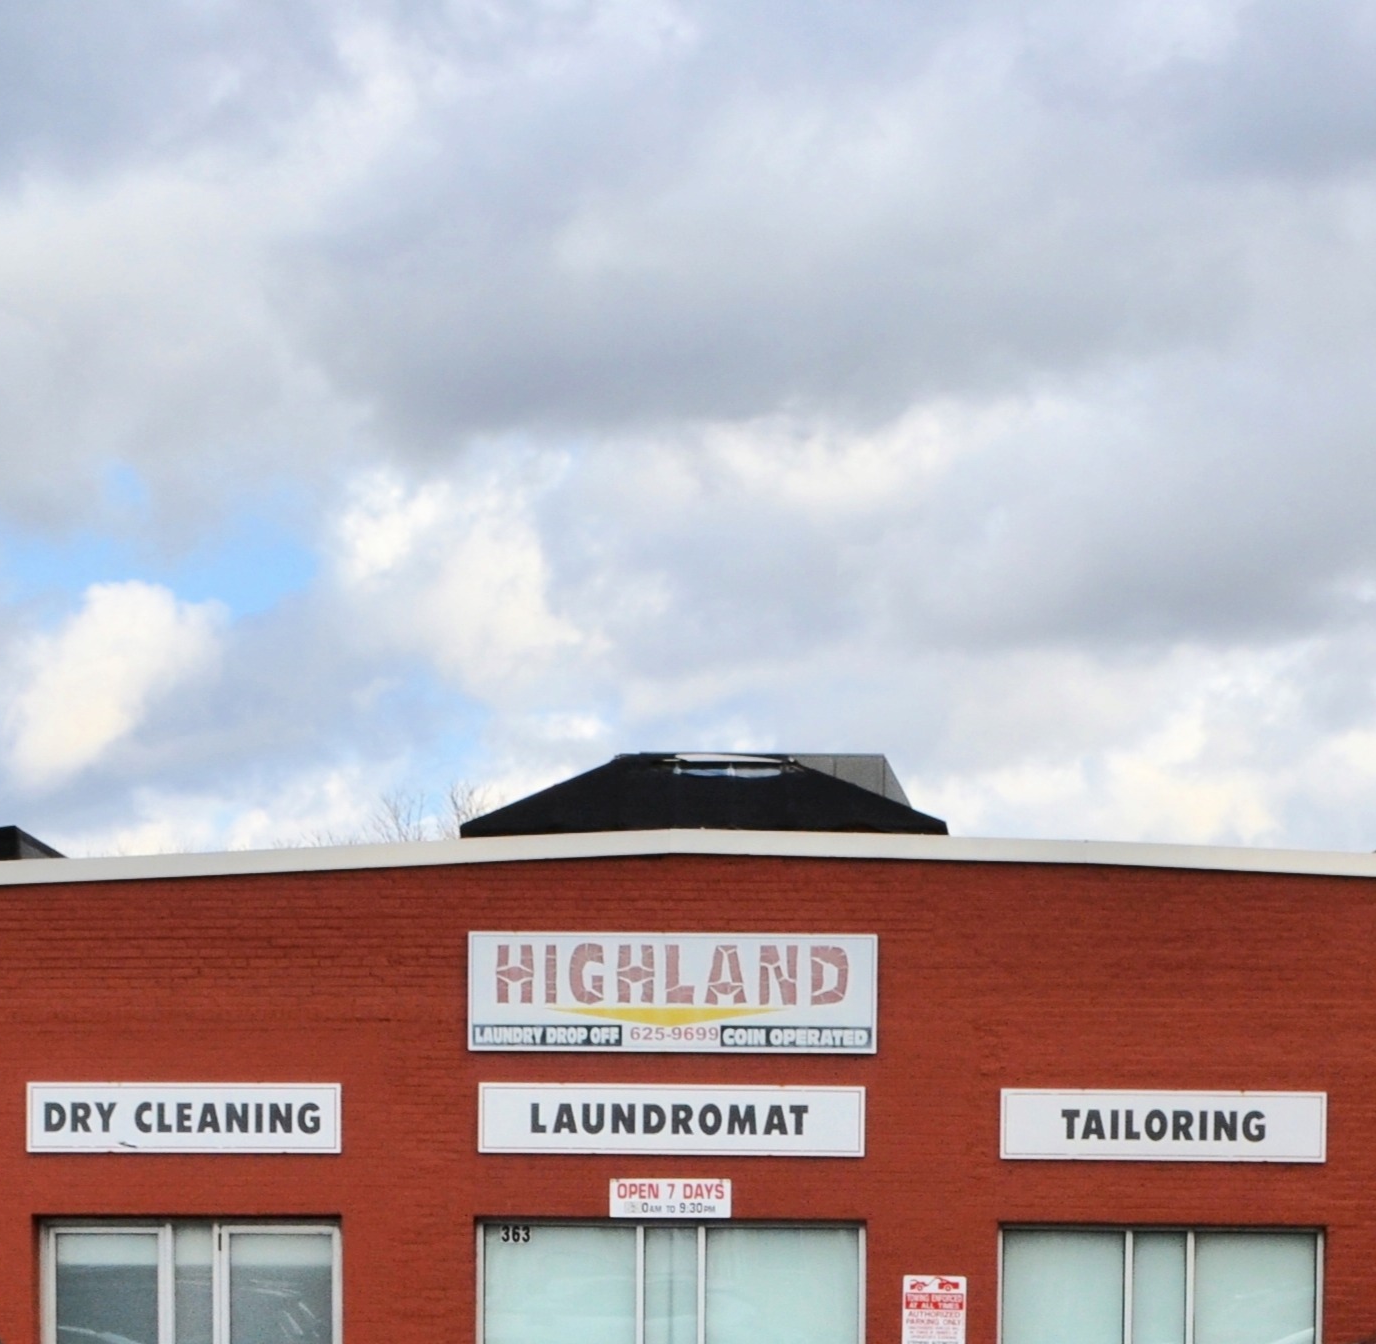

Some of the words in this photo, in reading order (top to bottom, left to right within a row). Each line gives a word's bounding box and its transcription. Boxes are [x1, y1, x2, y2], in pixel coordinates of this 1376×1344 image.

[496, 942, 849, 1006] HIGHLAND
[474, 1026, 544, 1045] LAUNDRY
[544, 1026, 587, 1045] DROP
[589, 1026, 621, 1045] OFF
[629, 1026, 719, 1042] 625-9699
[722, 1027, 767, 1047] COIN
[769, 1027, 869, 1047] OPERATED
[43, 1101, 117, 1133] DRY
[133, 1101, 322, 1135] CLEANING
[530, 1102, 809, 1136] LAUNDROMAT
[1060, 1108, 1266, 1142] TAILORING
[617, 1183, 660, 1200] OPEN
[666, 1183, 676, 1200] 7
[683, 1183, 725, 1200] DAYS
[501, 1224, 531, 1243] 363
